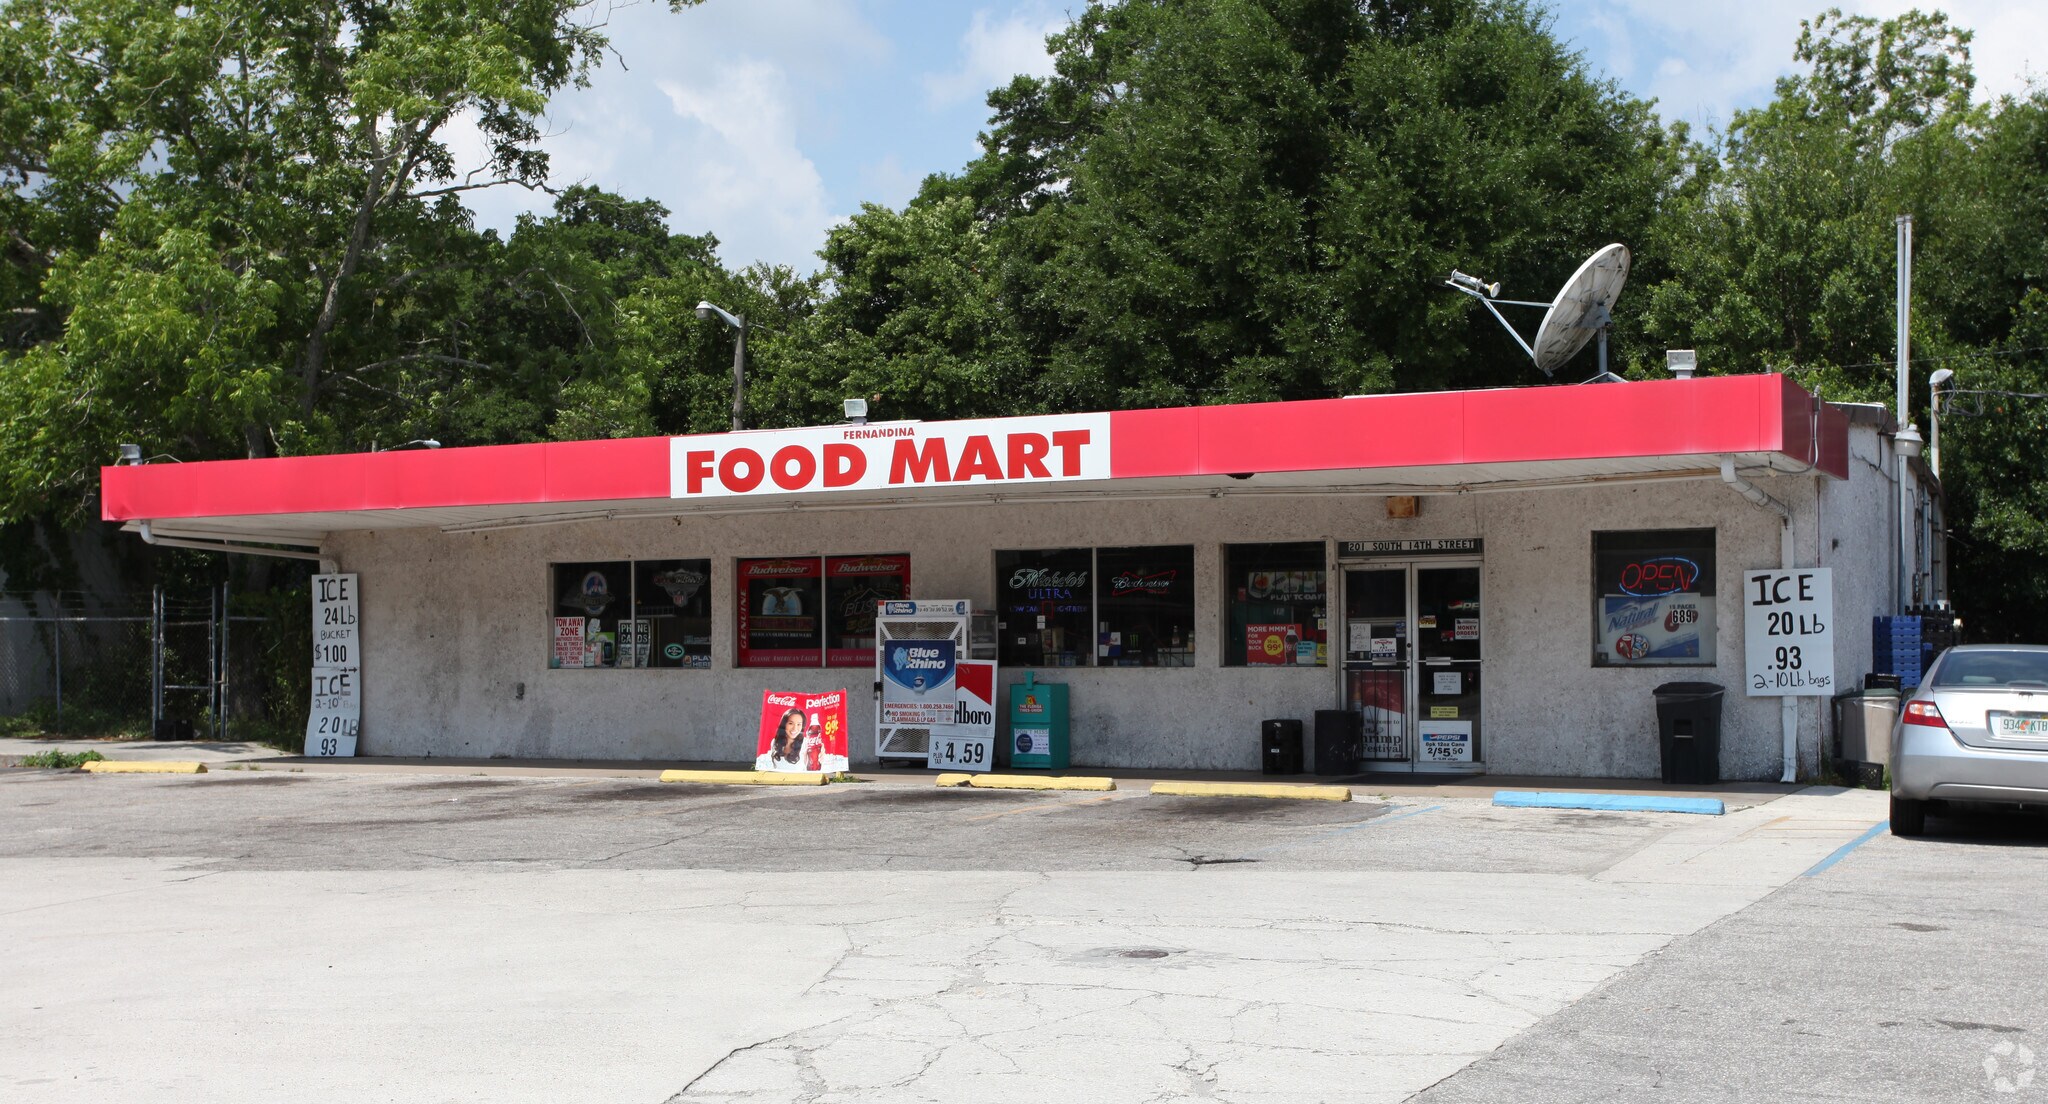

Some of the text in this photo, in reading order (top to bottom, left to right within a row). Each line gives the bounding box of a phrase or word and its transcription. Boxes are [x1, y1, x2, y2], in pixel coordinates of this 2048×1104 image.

[843, 427, 915, 440] FERNANDINA
[686, 429, 1091, 494] FOOD MART
[1349, 540, 1474, 551] 201 SOUTH 14TH STREET
[748, 565, 807, 575] Budweiser
[838, 563, 900, 573] Budweiser
[1009, 568, 1088, 589] Michelob
[1111, 576, 1170, 589] Budweiser
[1621, 563, 1692, 591] OPEN
[318, 578, 349, 602] ICE
[1028, 588, 1073, 599] ULTRA
[1751, 574, 1814, 606] ICE
[325, 607, 338, 625] 24
[556, 618, 584, 627] TOW AWAY
[1608, 602, 1660, 633] Natural
[1672, 609, 1692, 623] 689
[621, 624, 648, 633] PHNE
[1767, 611, 1825, 636] 20 Lb
[321, 629, 351, 640] BUCKET
[560, 627, 579, 636] ZONE
[621, 634, 648, 643] CADS
[800, 654, 818, 662] LAGER
[831, 654, 853, 662] CLASSIC
[909, 647, 939, 658] Blue
[906, 657, 946, 670] Rhino
[315, 674, 351, 697] ICE
[1808, 670, 1831, 688] bags
[806, 693, 840, 709] perfection
[954, 701, 992, 725] rlboro
[319, 717, 340, 733] 20
[2003, 718, 2020, 730] 934
[321, 738, 337, 756] 93
[935, 741, 940, 751] $
[1361, 734, 1402, 747] hrimp
